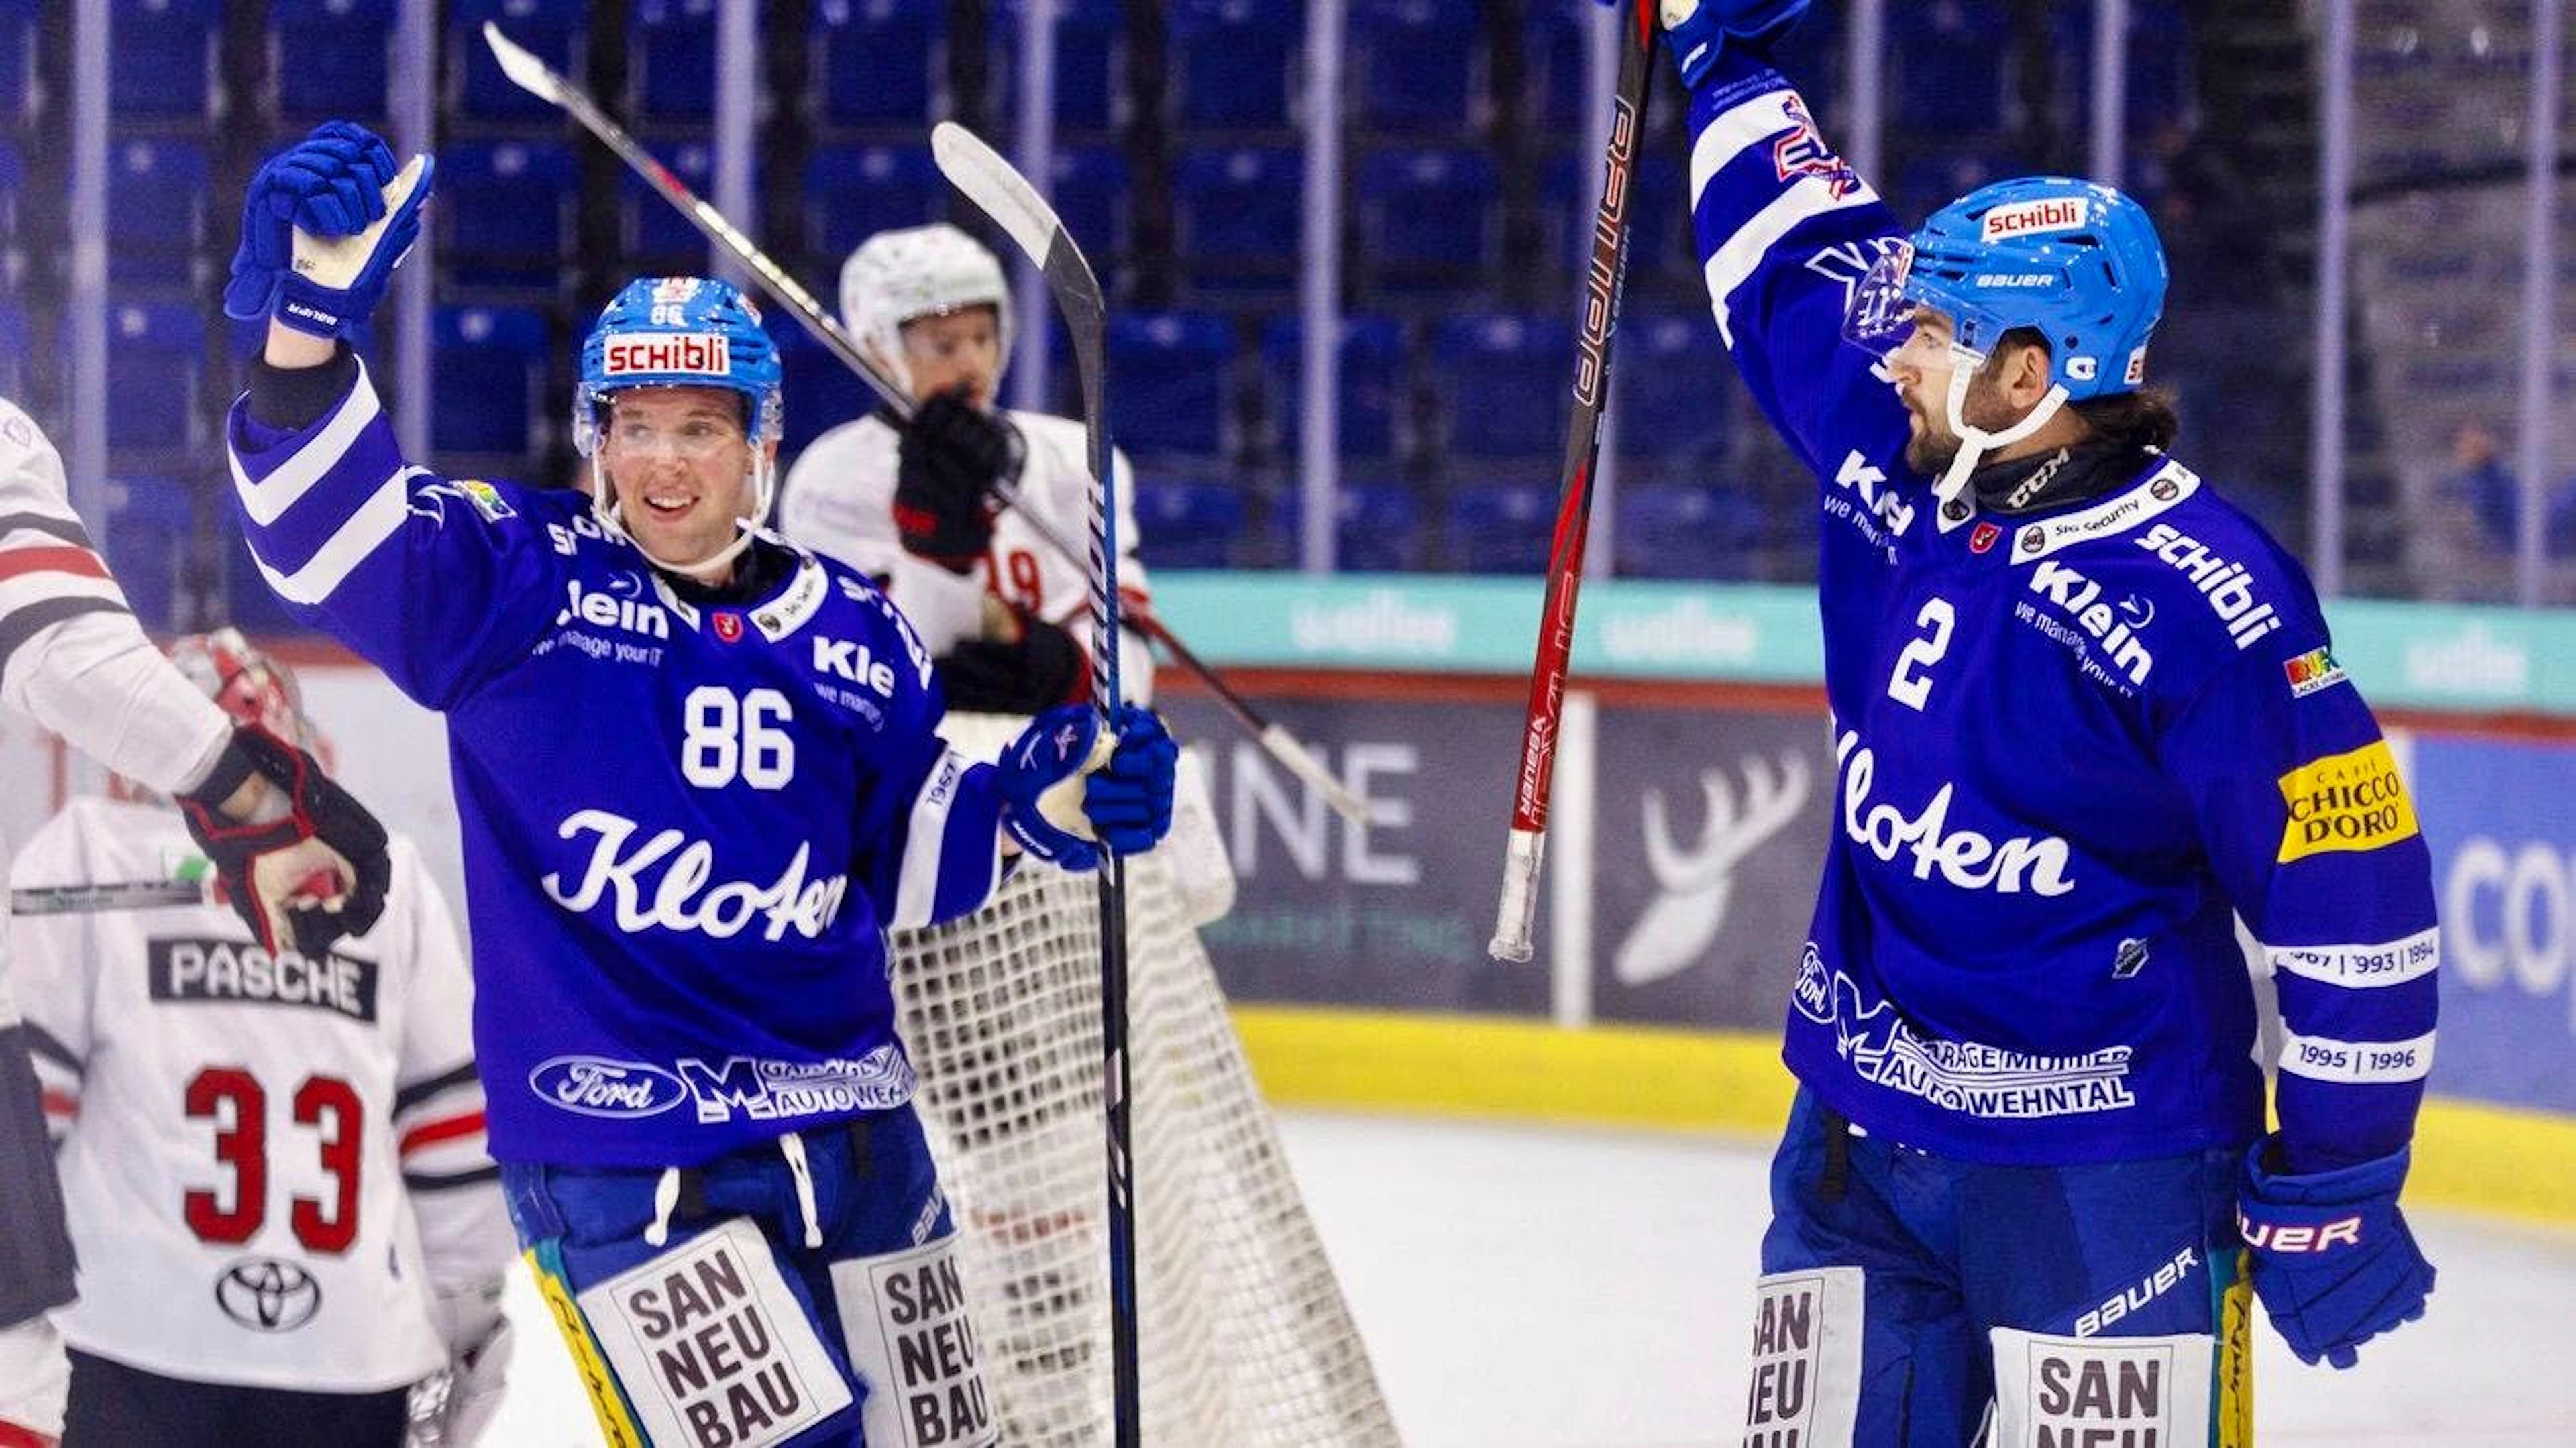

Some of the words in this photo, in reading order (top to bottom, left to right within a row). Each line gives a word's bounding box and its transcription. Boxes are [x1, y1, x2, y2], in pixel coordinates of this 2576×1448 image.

[1977, 274, 2055, 287] BAUER
[2006, 446, 2071, 508] CCM
[2083, 498, 2139, 531] Security
[556, 580, 669, 641] lein
[2029, 561, 2153, 686] Klein
[1887, 597, 1955, 712] 2
[682, 685, 794, 790] 86
[1520, 727, 1544, 814] BAUER
[1837, 730, 2075, 897] loten
[2290, 771, 2400, 823] CHICCO
[541, 809, 847, 942] Kloten
[2446, 837, 2576, 996] CO
[171, 944, 362, 1017] PASCHE
[2354, 952, 2395, 974] 993
[2408, 942, 2434, 966] 1994
[557, 1063, 655, 1111] Ford
[2299, 1044, 2347, 1069] 1995
[2369, 1048, 2416, 1072] 1996
[777, 1087, 851, 1119] AUTO
[1968, 1076, 2136, 1117] WEHNTAL
[184, 1065, 364, 1256] 33
[2238, 1215, 2363, 1253] UER
[628, 1249, 747, 1340] SAN
[884, 1254, 965, 1327] SAN
[1752, 1291, 1813, 1359] AN
[2076, 1245, 2200, 1339] BAUER
[656, 1305, 771, 1400] NEU
[898, 1313, 973, 1388] NEU
[684, 1361, 801, 1448] BAU
[908, 1374, 989, 1447] BAU
[1746, 1359, 1807, 1427] EU
[2039, 1356, 2161, 1421] SAN
